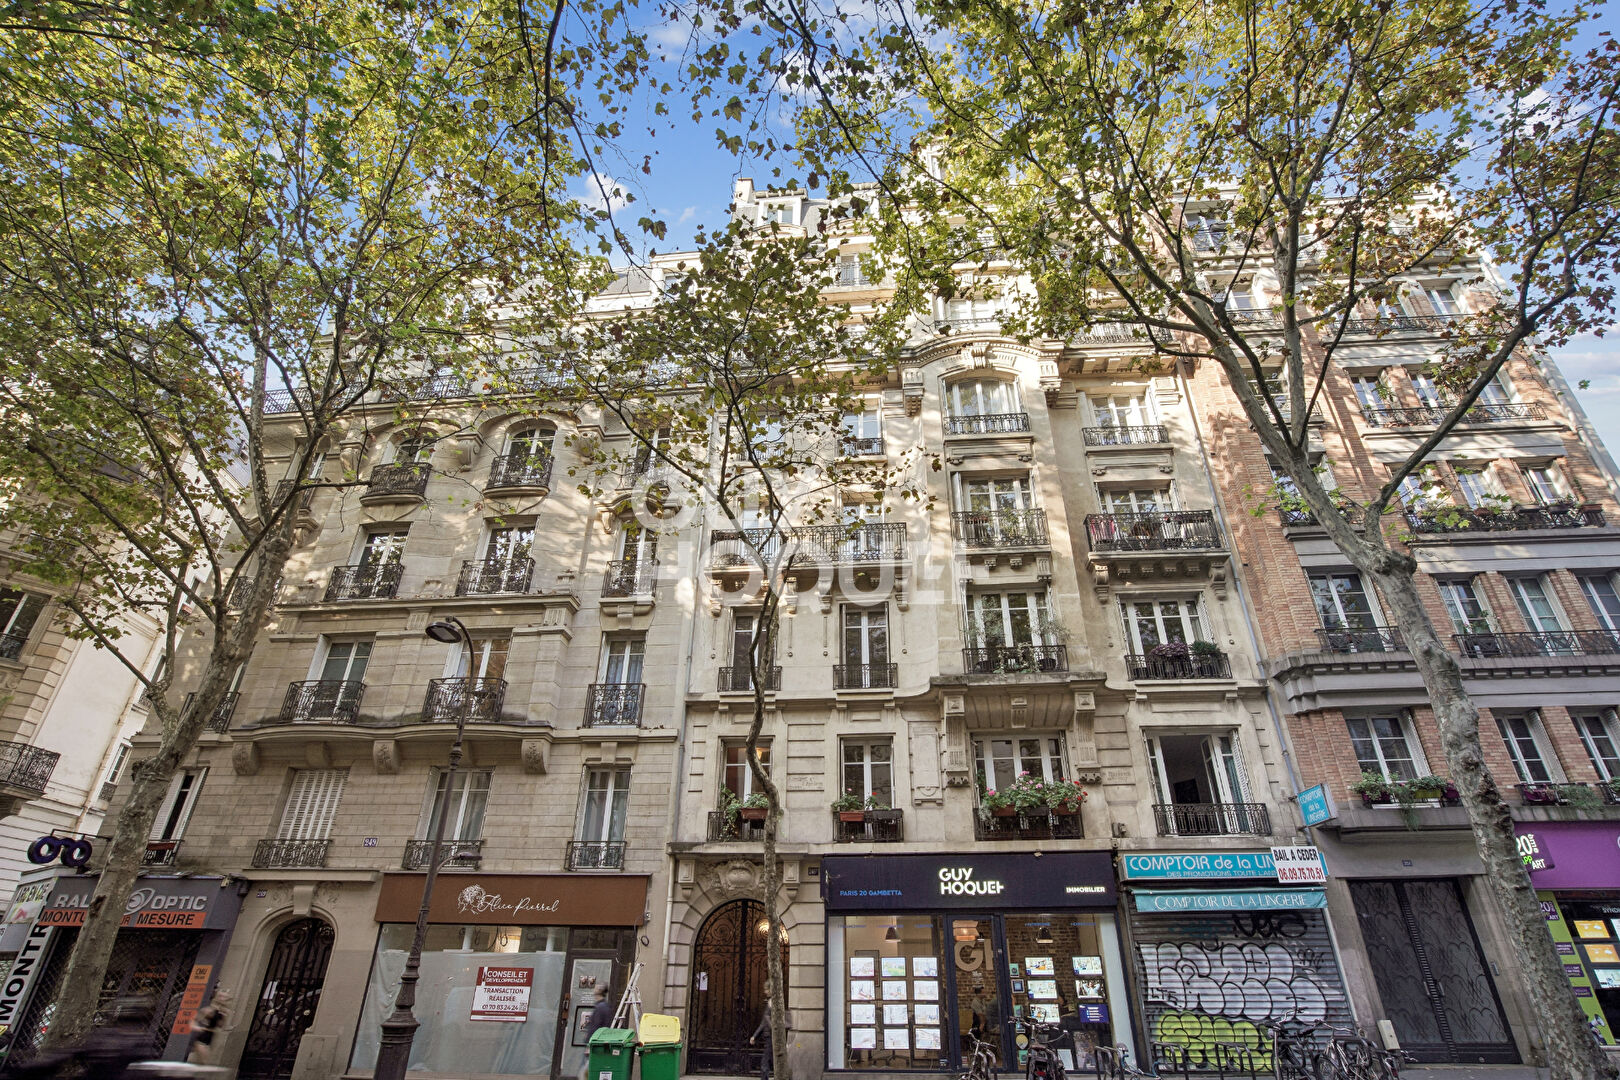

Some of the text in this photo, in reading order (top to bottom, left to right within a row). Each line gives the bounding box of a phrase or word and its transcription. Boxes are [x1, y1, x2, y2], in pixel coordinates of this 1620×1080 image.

[364, 838, 377, 847] 249
[1273, 848, 1319, 861] BAIL A CEDER
[1129, 854, 1277, 871] COMPTOIR de la LIN
[1532, 859, 1546, 869] ART
[938, 867, 973, 882] GUY
[1183, 870, 1232, 878] PROMOTIONS
[1278, 867, 1324, 880] 06.09.75.70.51
[868, 889, 902, 897] GAMBETTA
[1065, 886, 1106, 894] IMMOBILIER
[150, 895, 208, 911] OPTIC
[1154, 893, 1307, 911] COMPTOIR DE LA LINGERIE
[136, 913, 195, 926] MESURE
[487, 970, 517, 978] CONSEIL
[483, 987, 524, 995] TRANSACTION
